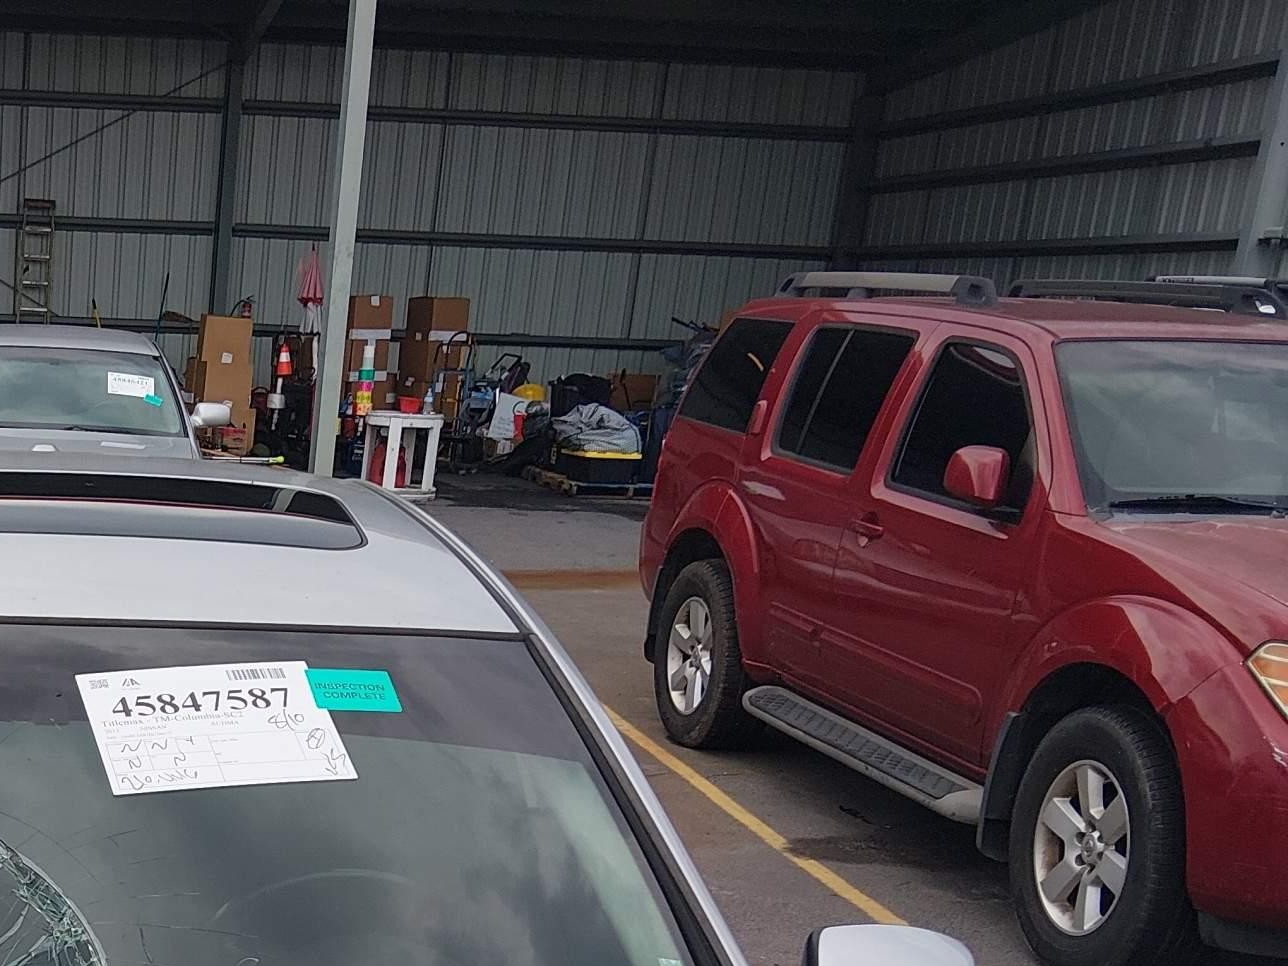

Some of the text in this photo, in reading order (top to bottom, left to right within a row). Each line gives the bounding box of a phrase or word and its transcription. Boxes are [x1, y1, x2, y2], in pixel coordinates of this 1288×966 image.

[315, 682, 385, 692] INSPECTION
[323, 691, 386, 700] COMPLETE
[112, 688, 288, 717] 45847587
